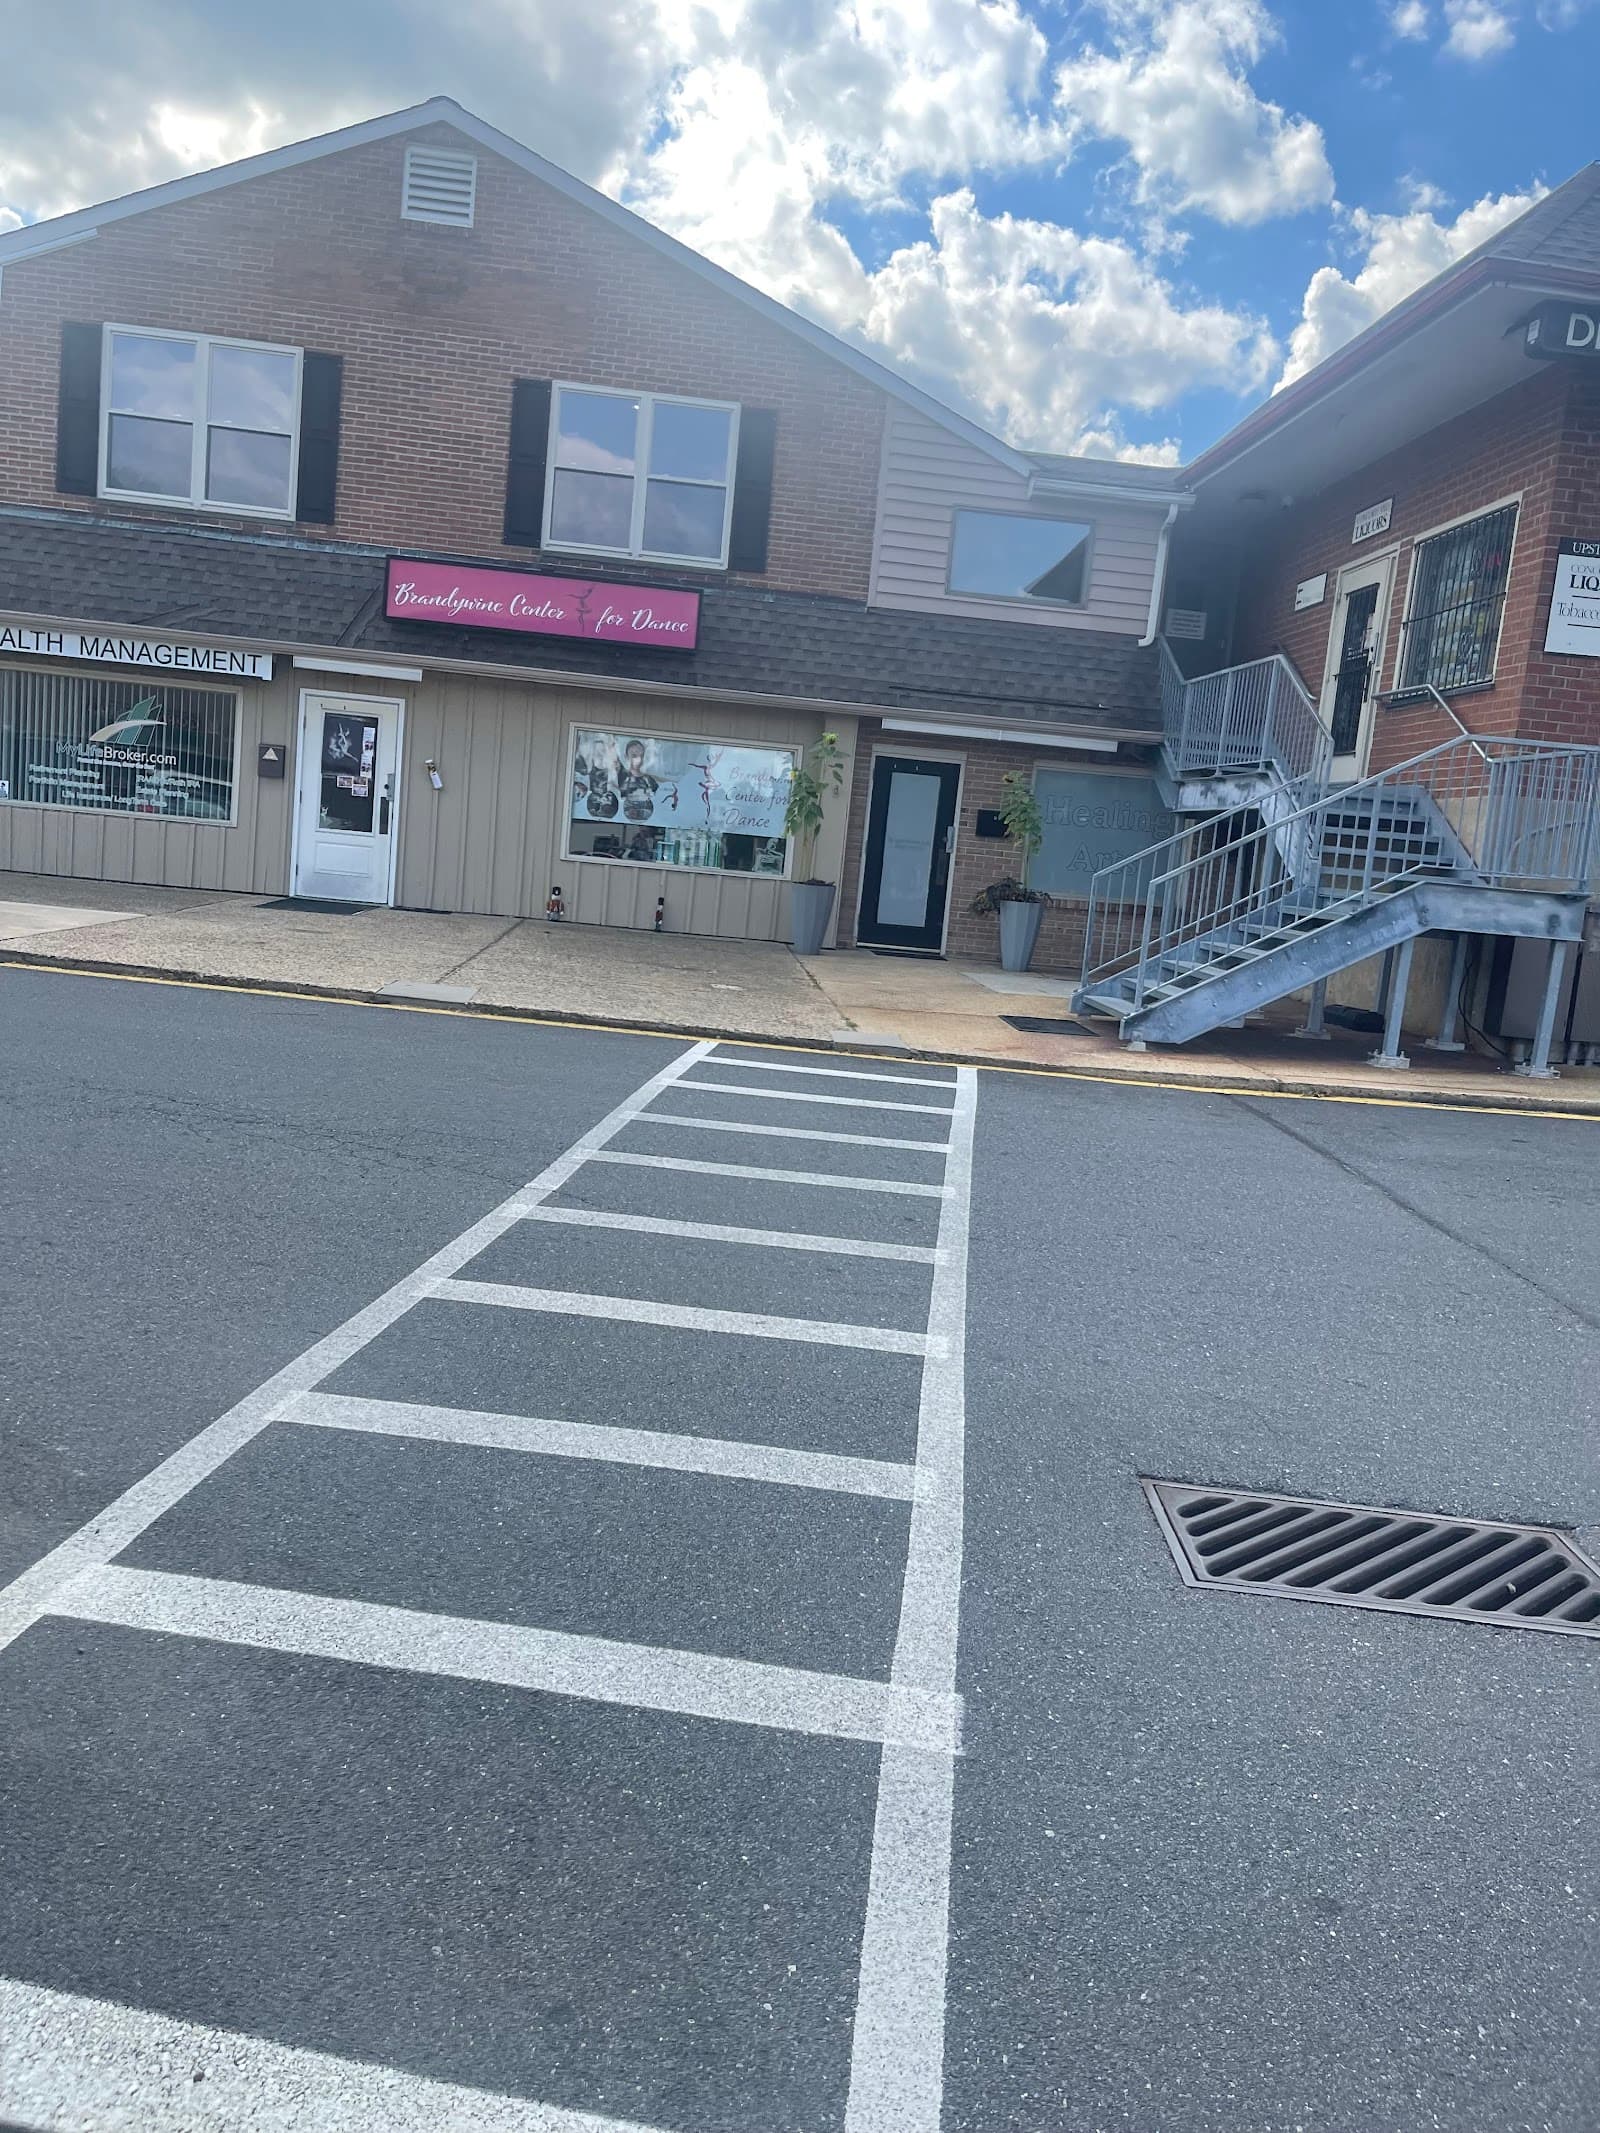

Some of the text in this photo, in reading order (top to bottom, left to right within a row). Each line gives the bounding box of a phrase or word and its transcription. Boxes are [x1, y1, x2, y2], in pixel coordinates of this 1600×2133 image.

[394, 582, 689, 634] Brandywine Center for Dance
[79, 636, 263, 674] MANAGEMENT
[56, 740, 177, 766] MyLifeBroker.com
[725, 786, 766, 803] Center
[723, 807, 770, 828] Dance
[1045, 794, 1173, 840] Healing
